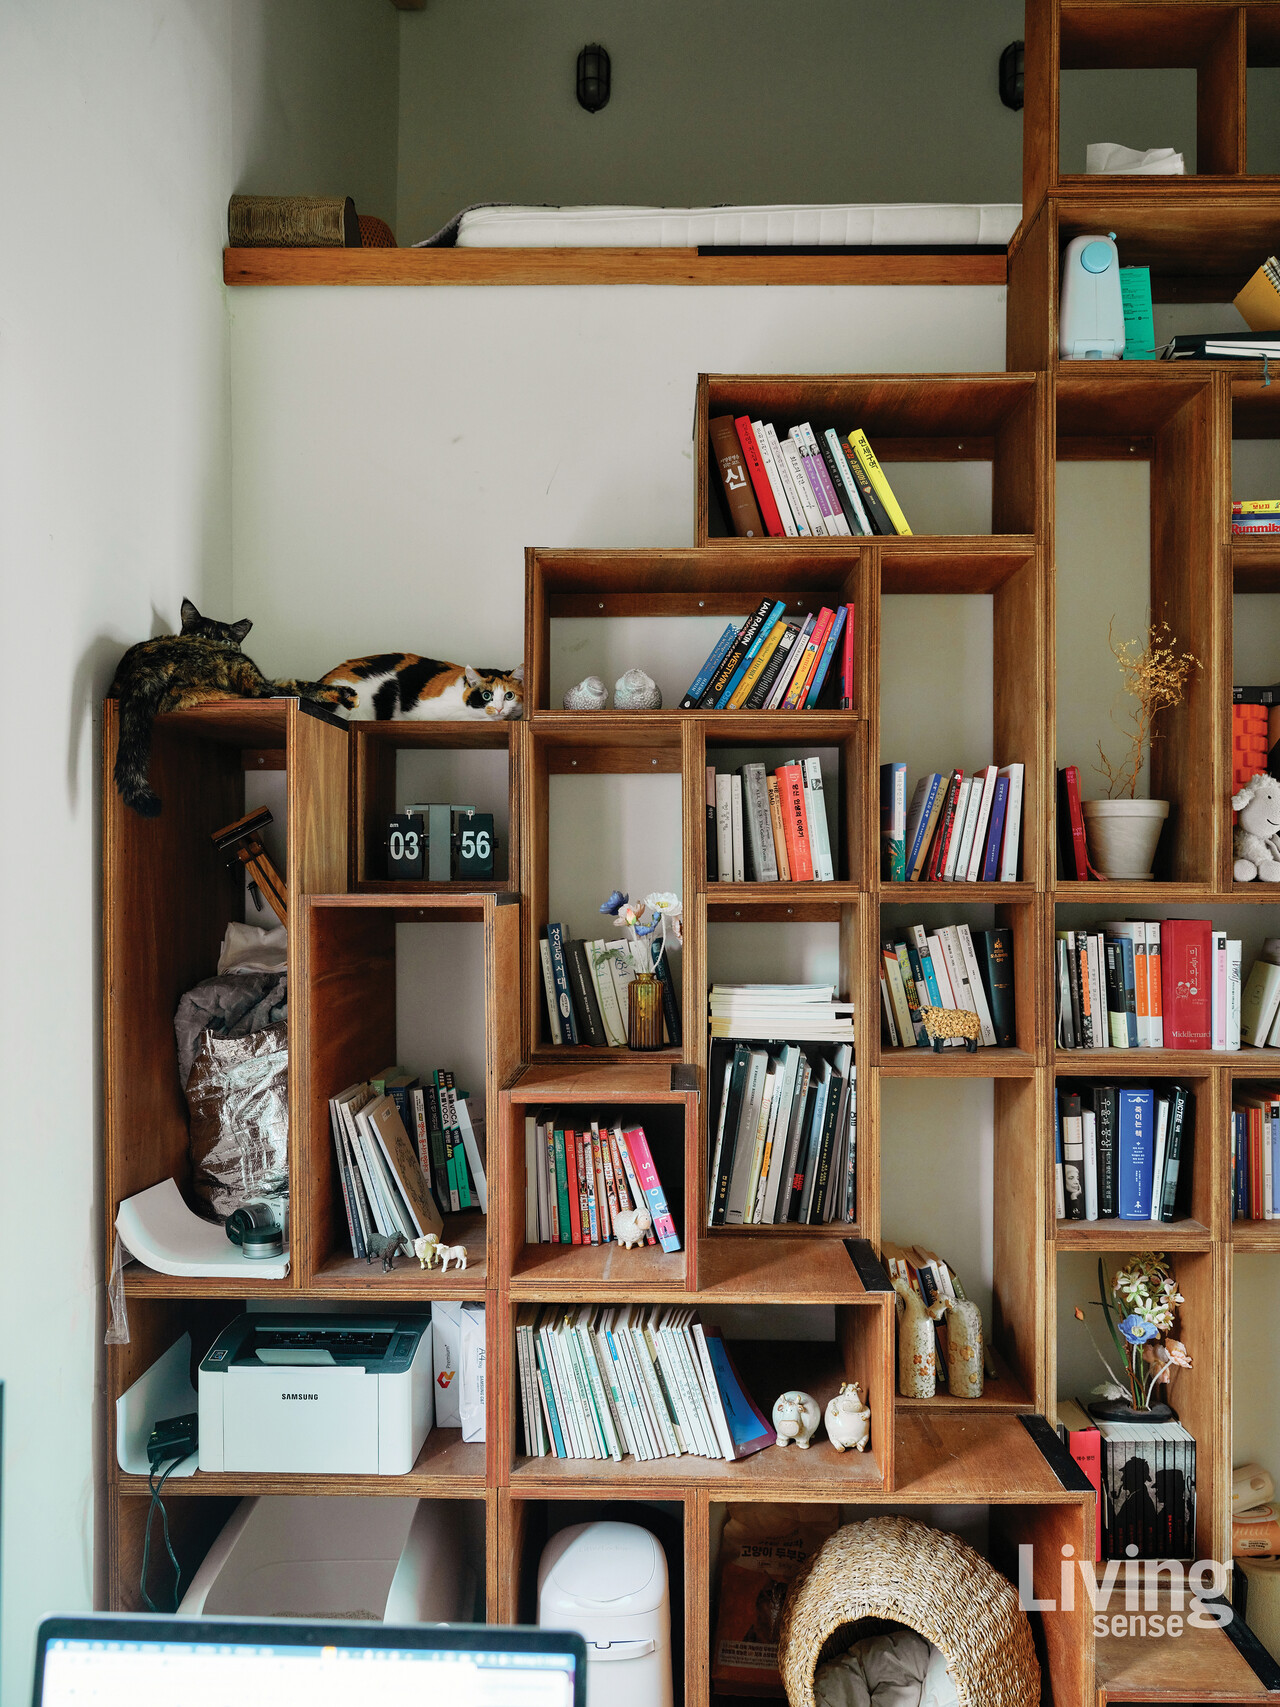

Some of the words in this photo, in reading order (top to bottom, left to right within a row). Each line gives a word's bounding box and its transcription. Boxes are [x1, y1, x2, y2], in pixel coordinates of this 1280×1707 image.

[726, 466, 747, 490] 신
[759, 601, 770, 616] IAN
[741, 614, 762, 646] RANKIN
[715, 651, 741, 692] WESTWIND
[800, 652, 812, 673] MATILDA
[791, 783, 799, 796] 당신
[793, 798, 802, 817] 인생의
[795, 818, 805, 838] 이야기
[390, 831, 419, 860] 03
[461, 831, 491, 859] 56
[556, 964, 566, 990] 시대
[1189, 946, 1198, 987] 미들마치
[1101, 1098, 1112, 1126] 우울과
[1134, 1106, 1142, 1128] 죽이는
[1176, 1098, 1185, 1124] DICTEE
[1101, 1128, 1112, 1148] 몽상
[1135, 1129, 1142, 1138] 책
[643, 1162, 666, 1223] SEOUL
[281, 1393, 319, 1401] SAMSUNG
[741, 1545, 772, 1558] 고양이
